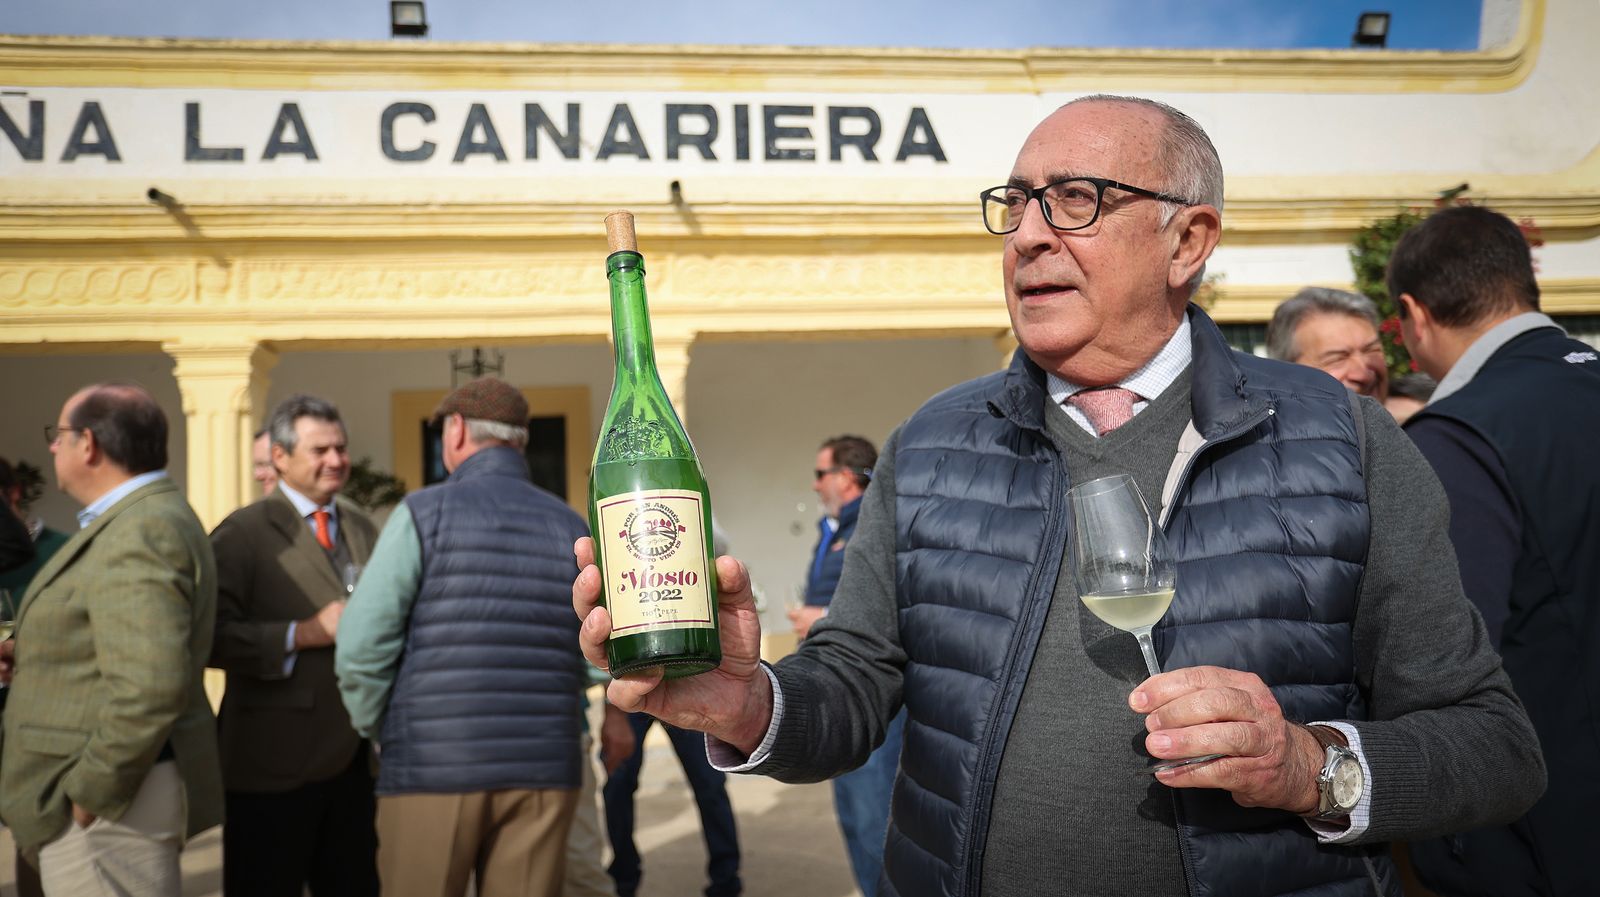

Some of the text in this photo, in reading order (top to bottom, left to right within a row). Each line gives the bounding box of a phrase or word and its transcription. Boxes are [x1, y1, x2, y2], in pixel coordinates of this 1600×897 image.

[184, 102, 319, 161] LA
[380, 101, 948, 163] CANARIERA
[623, 511, 635, 528] POR
[634, 502, 651, 513] AN
[625, 544, 633, 554] EL
[632, 552, 657, 563] MOTO
[659, 549, 676, 561] VINO
[617, 566, 698, 595] Mosto
[638, 588, 683, 604] 2022
